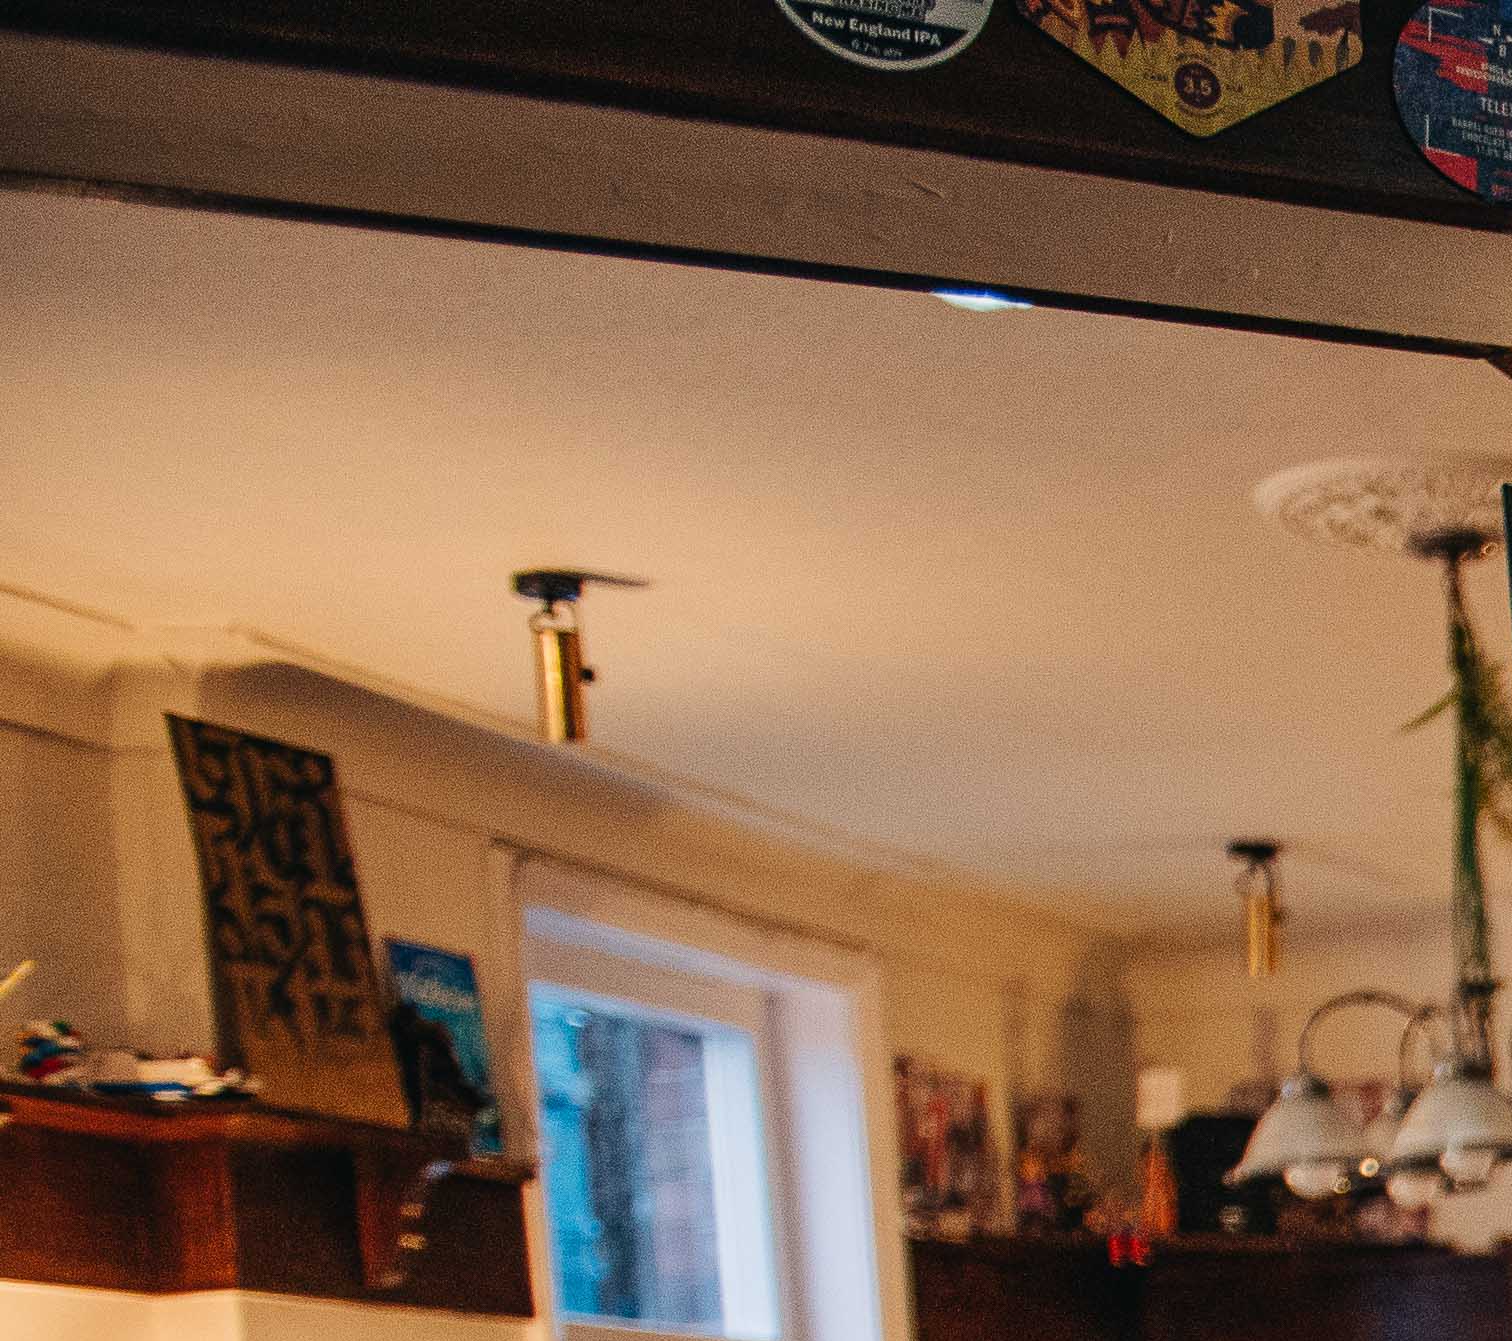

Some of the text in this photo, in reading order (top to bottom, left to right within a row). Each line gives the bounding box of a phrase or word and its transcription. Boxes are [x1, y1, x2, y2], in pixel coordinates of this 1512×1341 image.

[812, 11, 942, 48] New England IPA
